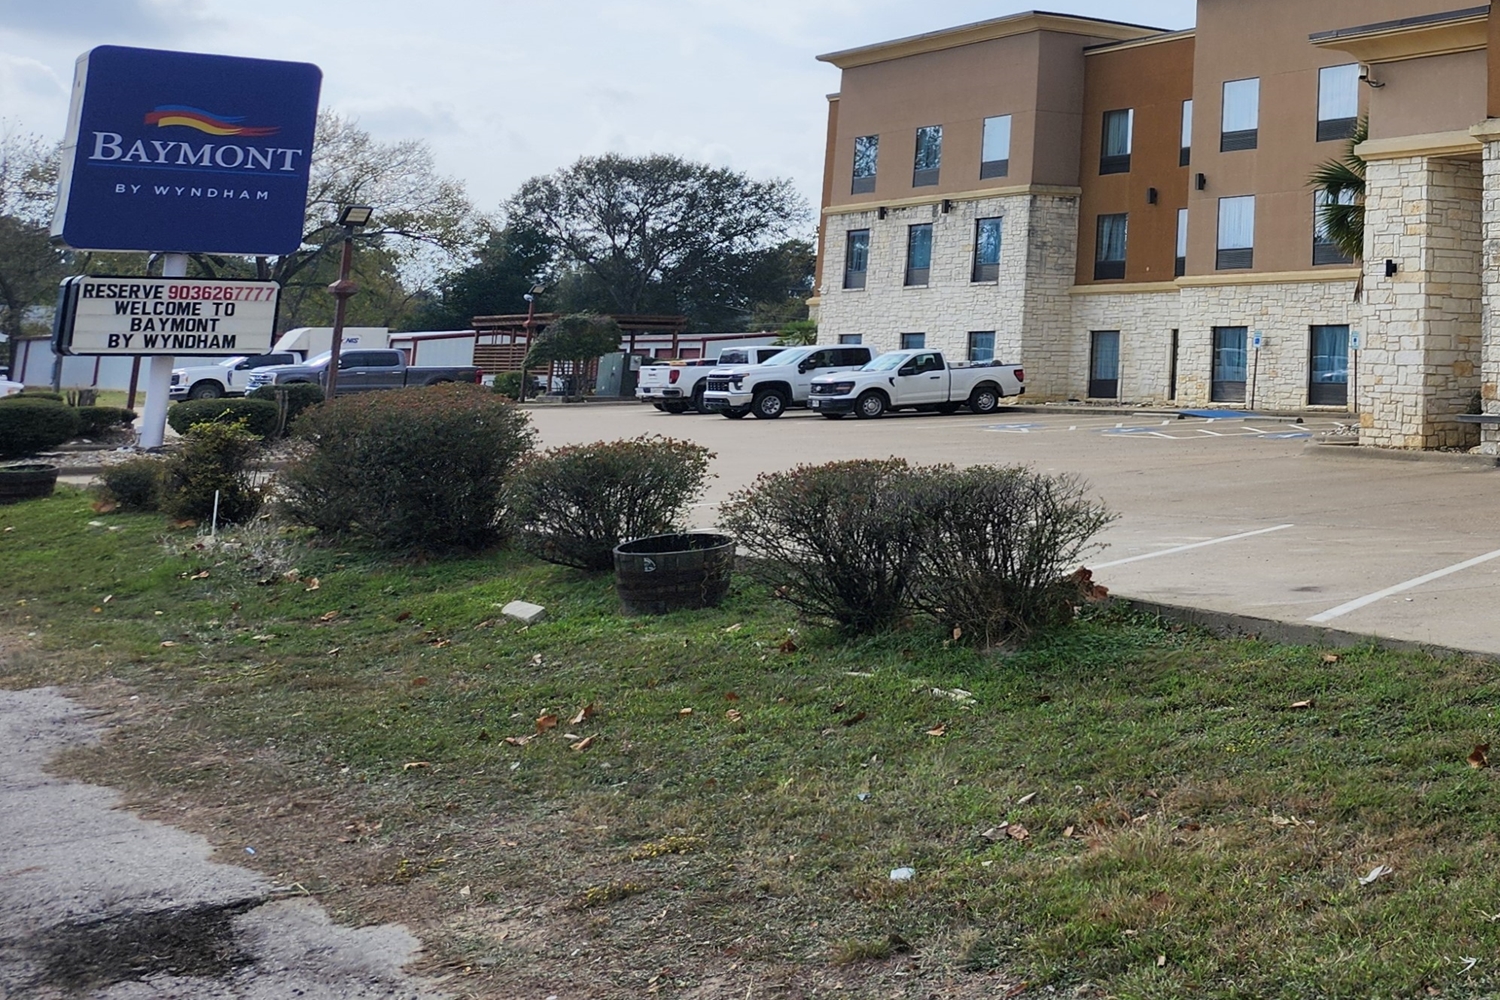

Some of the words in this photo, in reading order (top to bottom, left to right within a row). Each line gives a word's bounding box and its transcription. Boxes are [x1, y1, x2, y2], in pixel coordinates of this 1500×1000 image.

[88, 131, 302, 171] BAYMONT
[115, 183, 141, 194] BY
[154, 185, 269, 200] WYNDHAM
[82, 283, 165, 299] RESERVE
[168, 285, 276, 301] 9036267777
[115, 300, 202, 316] WELCOME
[212, 302, 235, 316] TO
[130, 317, 220, 332] BAYMONT
[108, 333, 134, 348] BY
[144, 334, 236, 349] WYNDHAM
